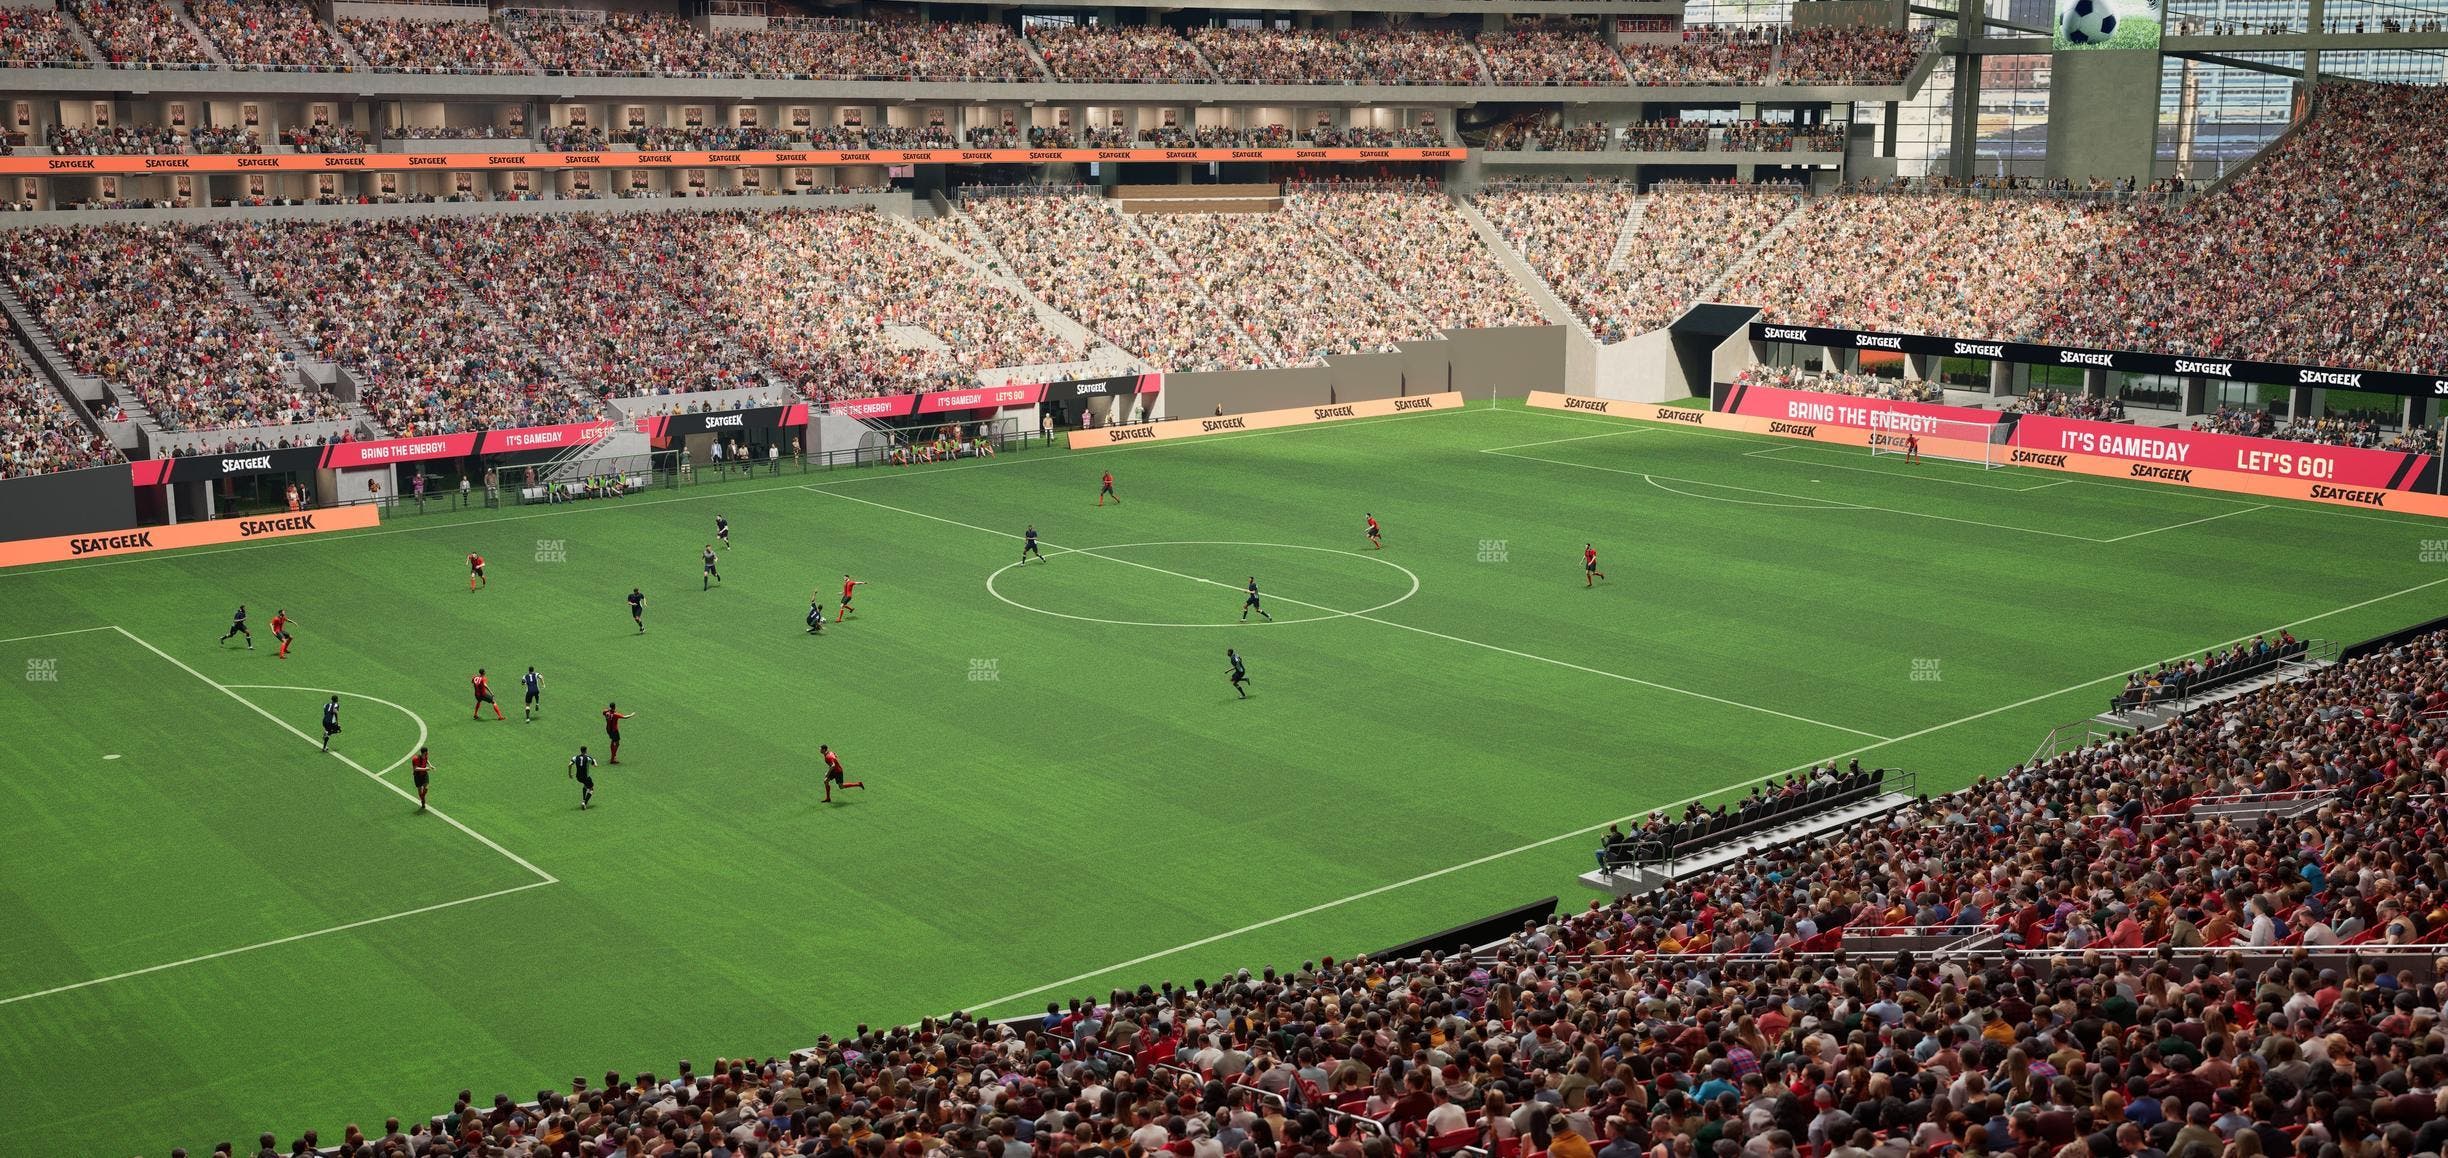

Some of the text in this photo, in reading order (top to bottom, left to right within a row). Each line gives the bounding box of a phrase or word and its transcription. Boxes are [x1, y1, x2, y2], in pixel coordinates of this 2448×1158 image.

[49, 160, 95, 169] SEATGEEK
[144, 159, 189, 168] SEATGEEK
[238, 158, 279, 167] SEATGEEK
[325, 158, 365, 166] SEATGEEK
[409, 157, 447, 165] SEATGEEK
[489, 156, 525, 164] SEATGEEK
[566, 156, 600, 164] SEATGEEK
[639, 155, 672, 163] SEATGEEK
[709, 154, 741, 162] SEATGEEK
[776, 154, 806, 162] SEATGEEK
[1765, 327, 1806, 341] SEATGEEK
[1856, 335, 1901, 349] SEATGEEK
[1955, 342, 2003, 357] SEATGEEK
[2061, 351, 2112, 366] SEATGEEK
[2175, 360, 2232, 376] SEATGEEK
[2300, 370, 2361, 387] SEATGEEK
[1077, 382, 1106, 394] SEATGEEK
[938, 394, 981, 406] IT'S GAMEDAY
[996, 390, 1025, 401] LET'S GO!
[863, 403, 892, 413] ENERGY!
[1315, 404, 1354, 419] SEATGEEK
[1393, 397, 1433, 412] SEATGEEK
[1565, 398, 1608, 412] SEATGEEK
[706, 414, 743, 428] SEATGEEK
[1657, 409, 1704, 424] SEATGEEK
[1788, 401, 1937, 434] BRING THE ENERGY!
[1203, 417, 1245, 431] SEATGEEK
[1769, 422, 1816, 437] SEATGEEK
[506, 432, 562, 446] IT'S GAMEDAY
[1110, 427, 1155, 441] SEATGEEK
[361, 442, 446, 459] BRING THE ENERGY!
[2061, 430, 2190, 462] IT'S GAMEDAY
[222, 456, 271, 472] SEATGEEK
[2011, 450, 2067, 467] SEATGEEK
[2237, 449, 2334, 479] LET'S GO!
[2131, 464, 2192, 483] SEATGEEK
[2311, 485, 2386, 506] SEATGEEK
[240, 515, 315, 536] SEATGEEK
[71, 532, 152, 554] SEATGEEK
